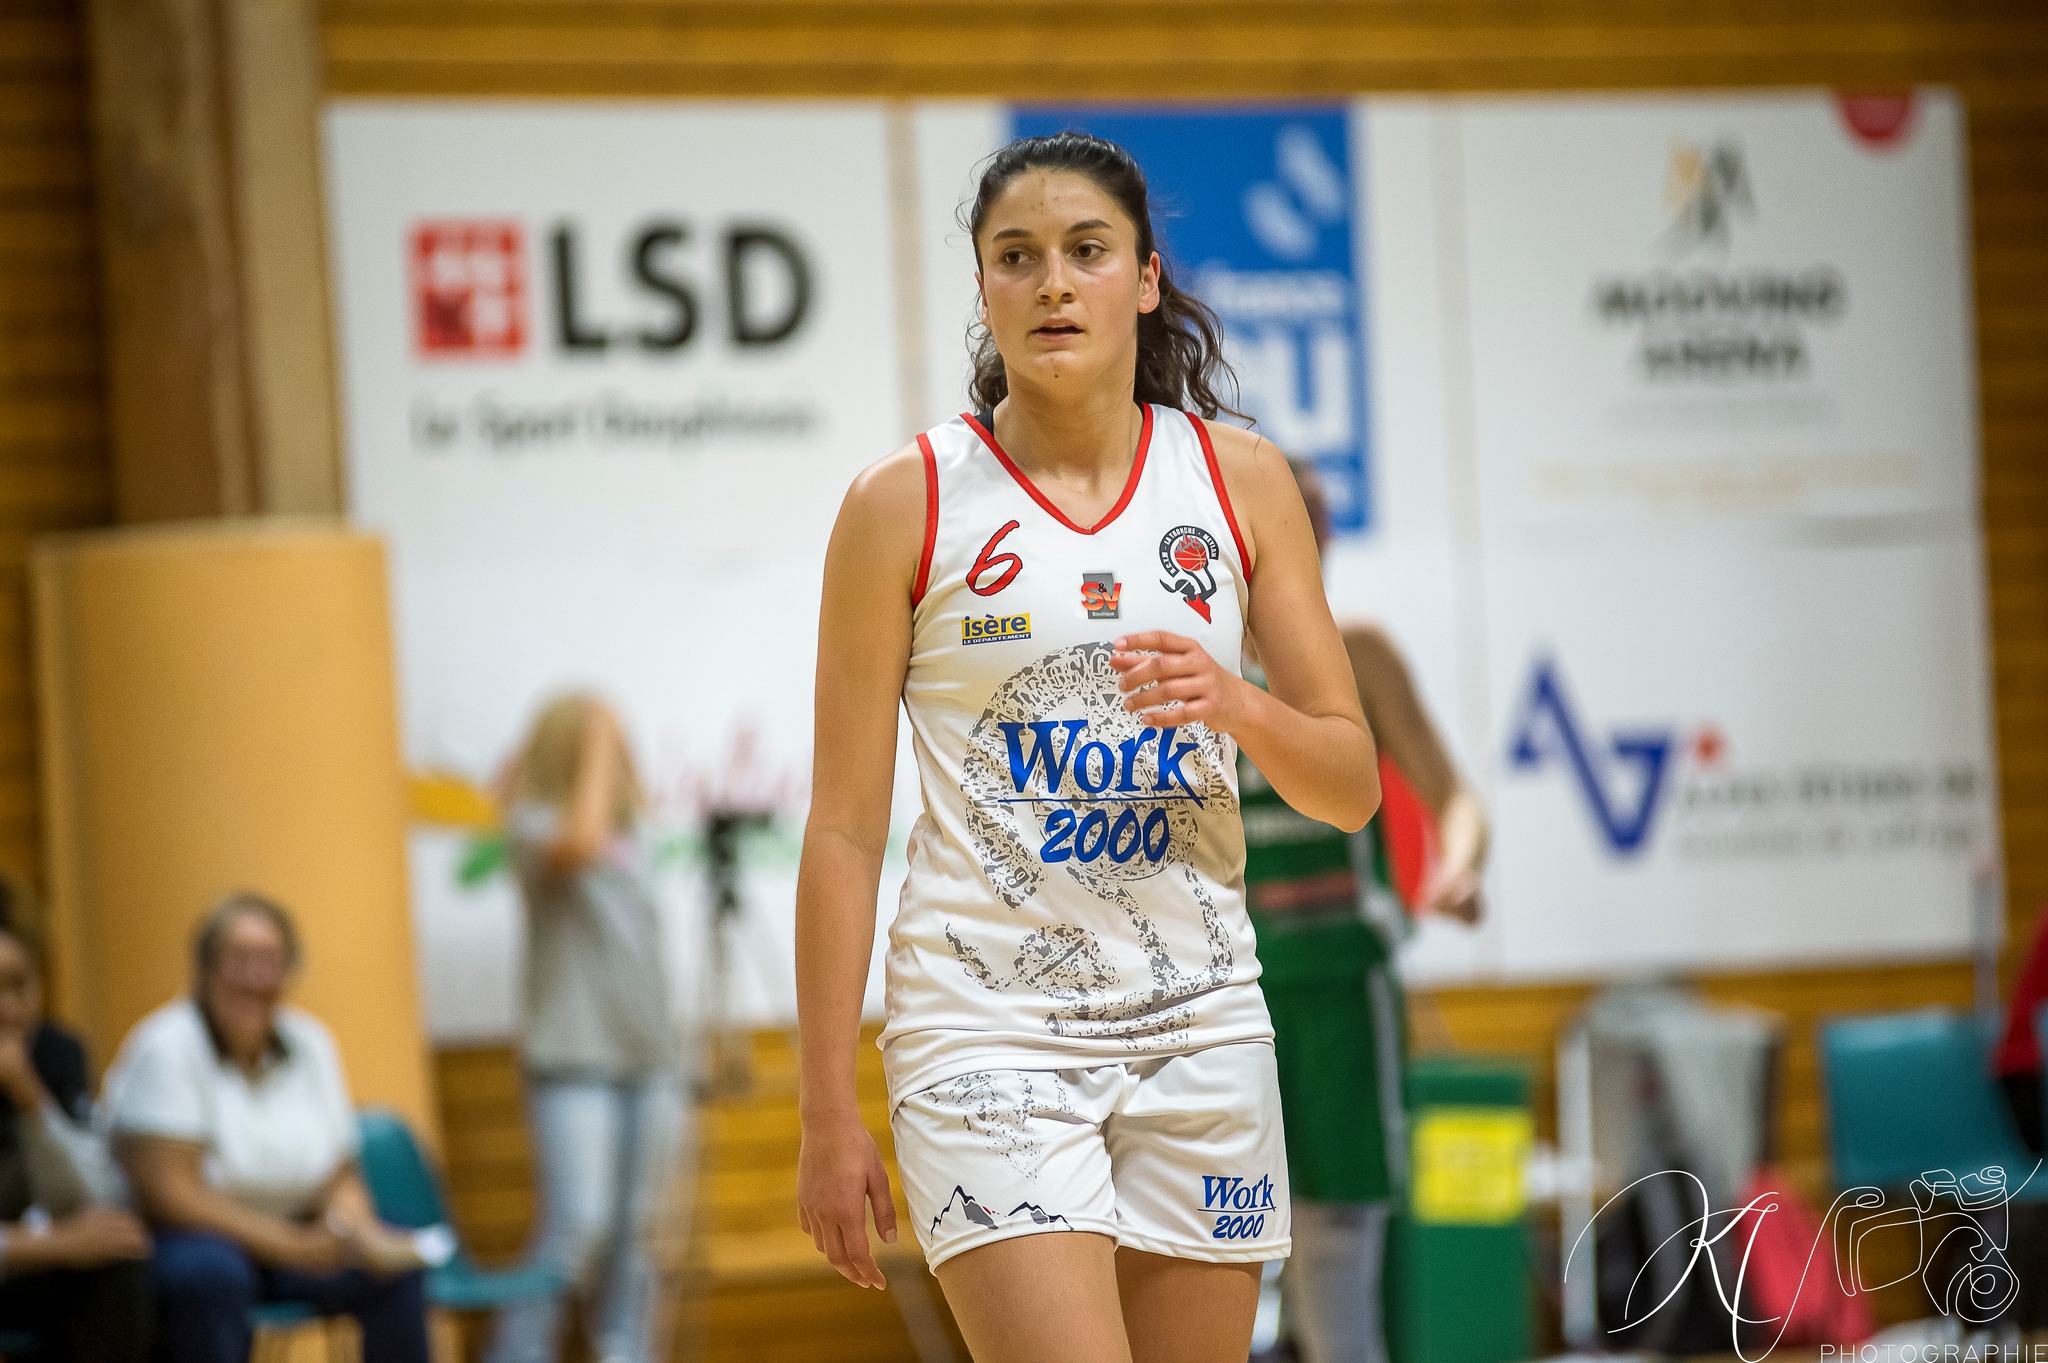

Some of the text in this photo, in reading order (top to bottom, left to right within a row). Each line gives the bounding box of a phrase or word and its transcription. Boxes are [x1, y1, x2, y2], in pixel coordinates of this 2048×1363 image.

[550, 214, 818, 353] LSD
[966, 519, 1023, 597] 6
[965, 613, 1027, 637] isère
[972, 633, 1030, 644] DÉPARTEMENT
[998, 719, 1206, 810] Work
[1040, 807, 1170, 864] 2000
[1201, 1173, 1276, 1212] Work
[1212, 1213, 1265, 1239] 2000
